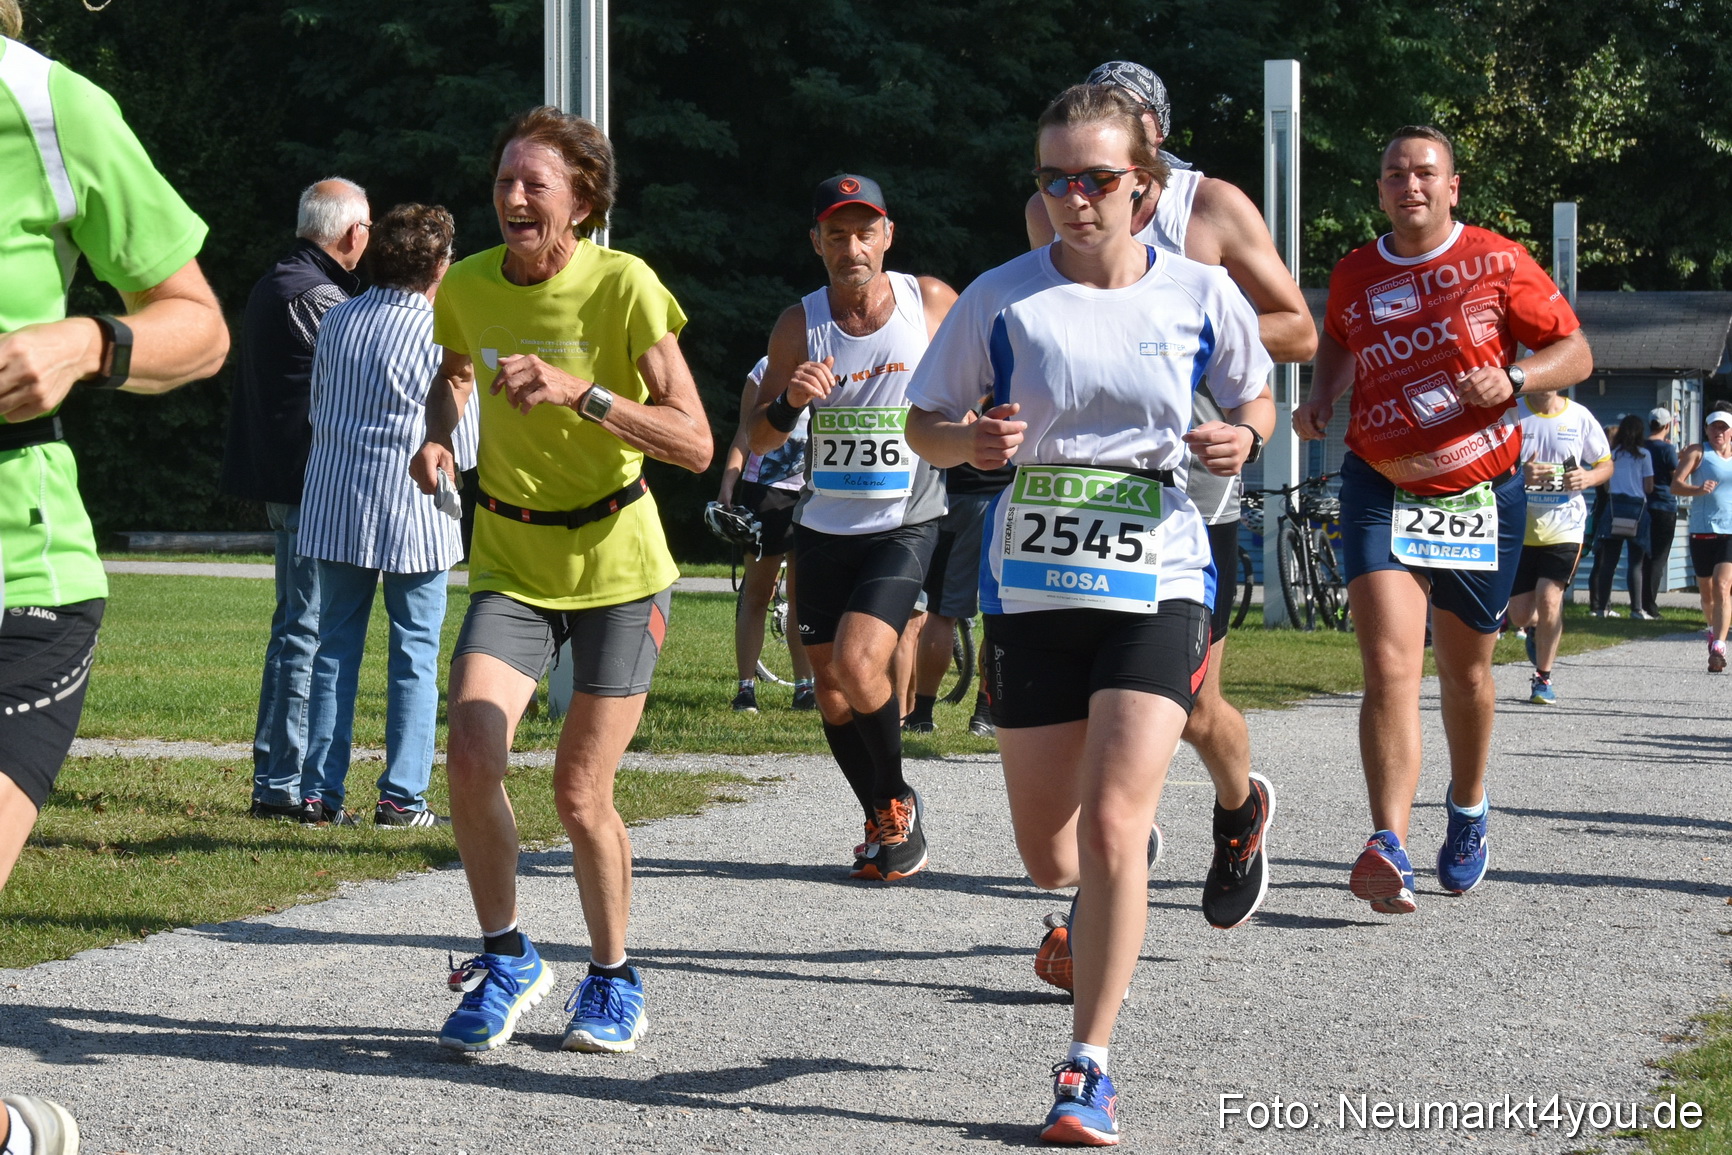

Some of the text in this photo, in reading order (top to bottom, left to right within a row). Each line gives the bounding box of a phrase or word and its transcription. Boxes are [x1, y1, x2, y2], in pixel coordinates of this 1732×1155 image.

[1421, 247, 1518, 295] raum
[1369, 276, 1411, 296] raumbox
[1428, 284, 1480, 308] schenken
[851, 362, 910, 382] KLEBL
[1407, 376, 1446, 397] raumbox
[817, 410, 905, 431] BOCK
[823, 439, 900, 467] 2736
[1433, 433, 1492, 468] raumbox
[843, 473, 886, 487] Roland
[1022, 471, 1152, 513] BOCK
[1528, 495, 1560, 503] HELMUT
[1406, 507, 1485, 538] 2262
[1021, 512, 1145, 563] 2545
[1149, 528, 1157, 537] C
[1406, 542, 1481, 559] ANDREAS
[1045, 569, 1110, 592] ROSA
[27, 606, 57, 621] JAKO
[995, 661, 1003, 700] odlo
